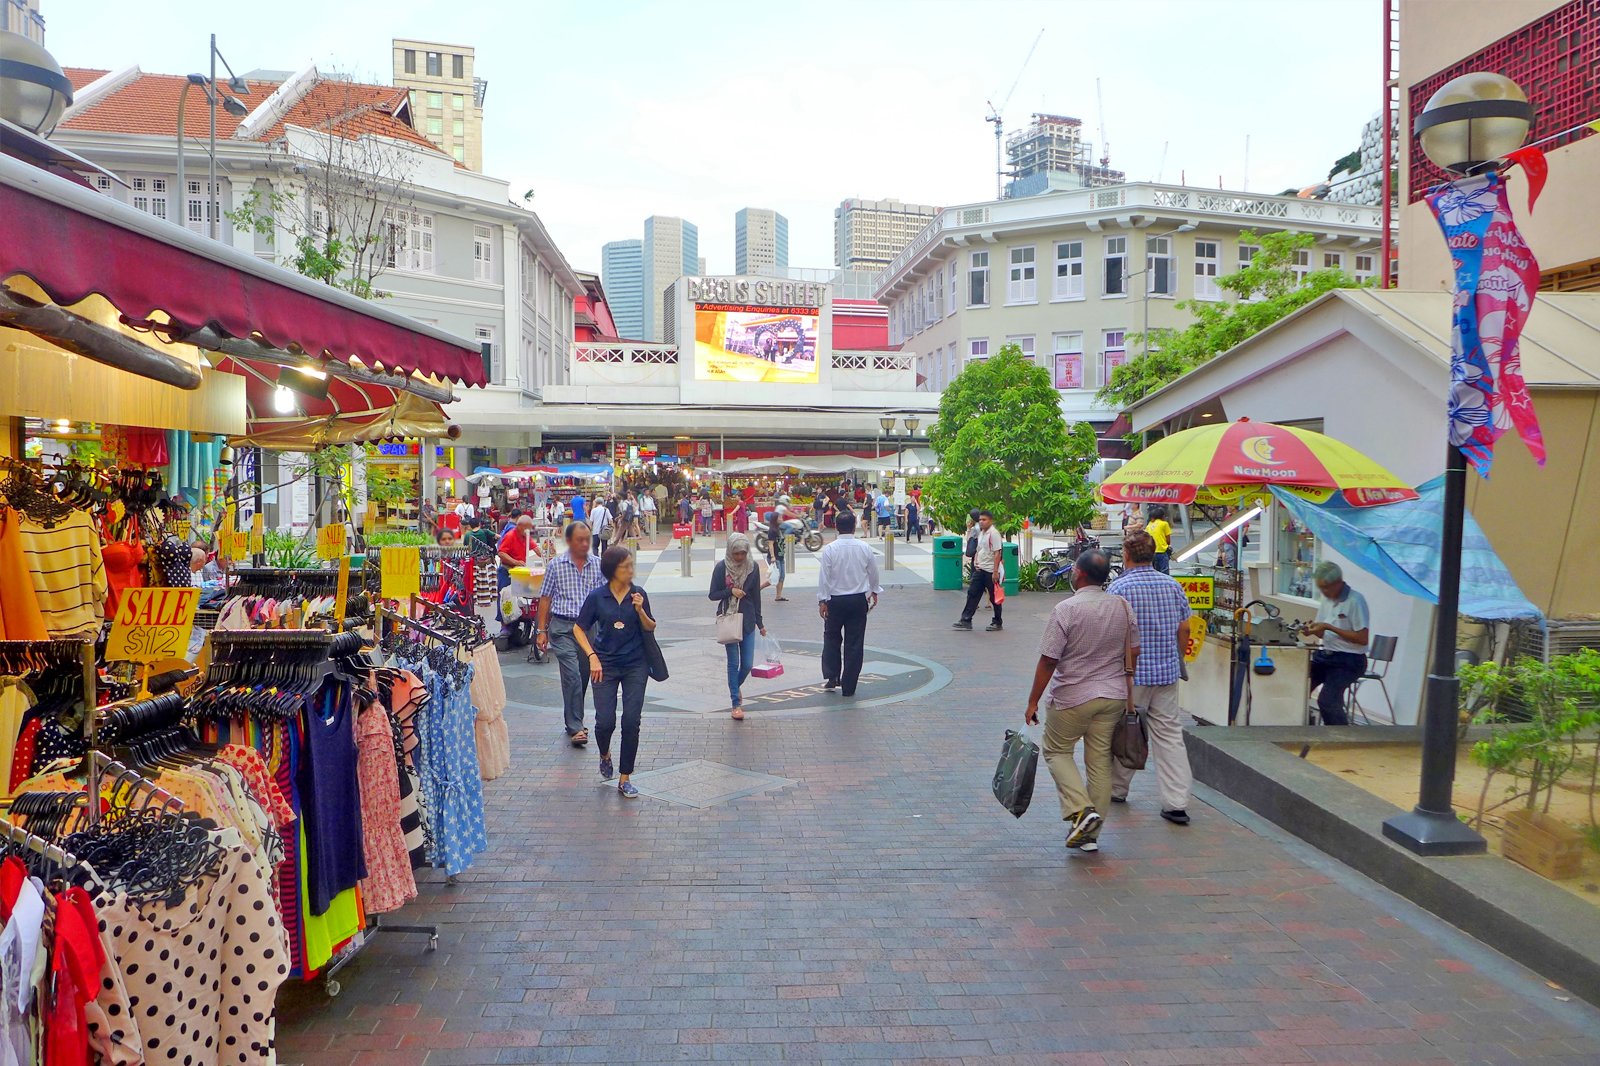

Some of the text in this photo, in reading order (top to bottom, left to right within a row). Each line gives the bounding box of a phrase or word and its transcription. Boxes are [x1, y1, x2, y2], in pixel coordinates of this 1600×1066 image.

[688, 277, 826, 307] BUGIS STREET
[702, 303, 744, 312] Advertising
[746, 305, 780, 314] Enquiries
[791, 307, 809, 315] 6333
[1131, 485, 1179, 498] NewMoon
[121, 589, 193, 626] SALE
[1188, 596, 1210, 605] ICATE
[123, 626, 180, 657] $12
